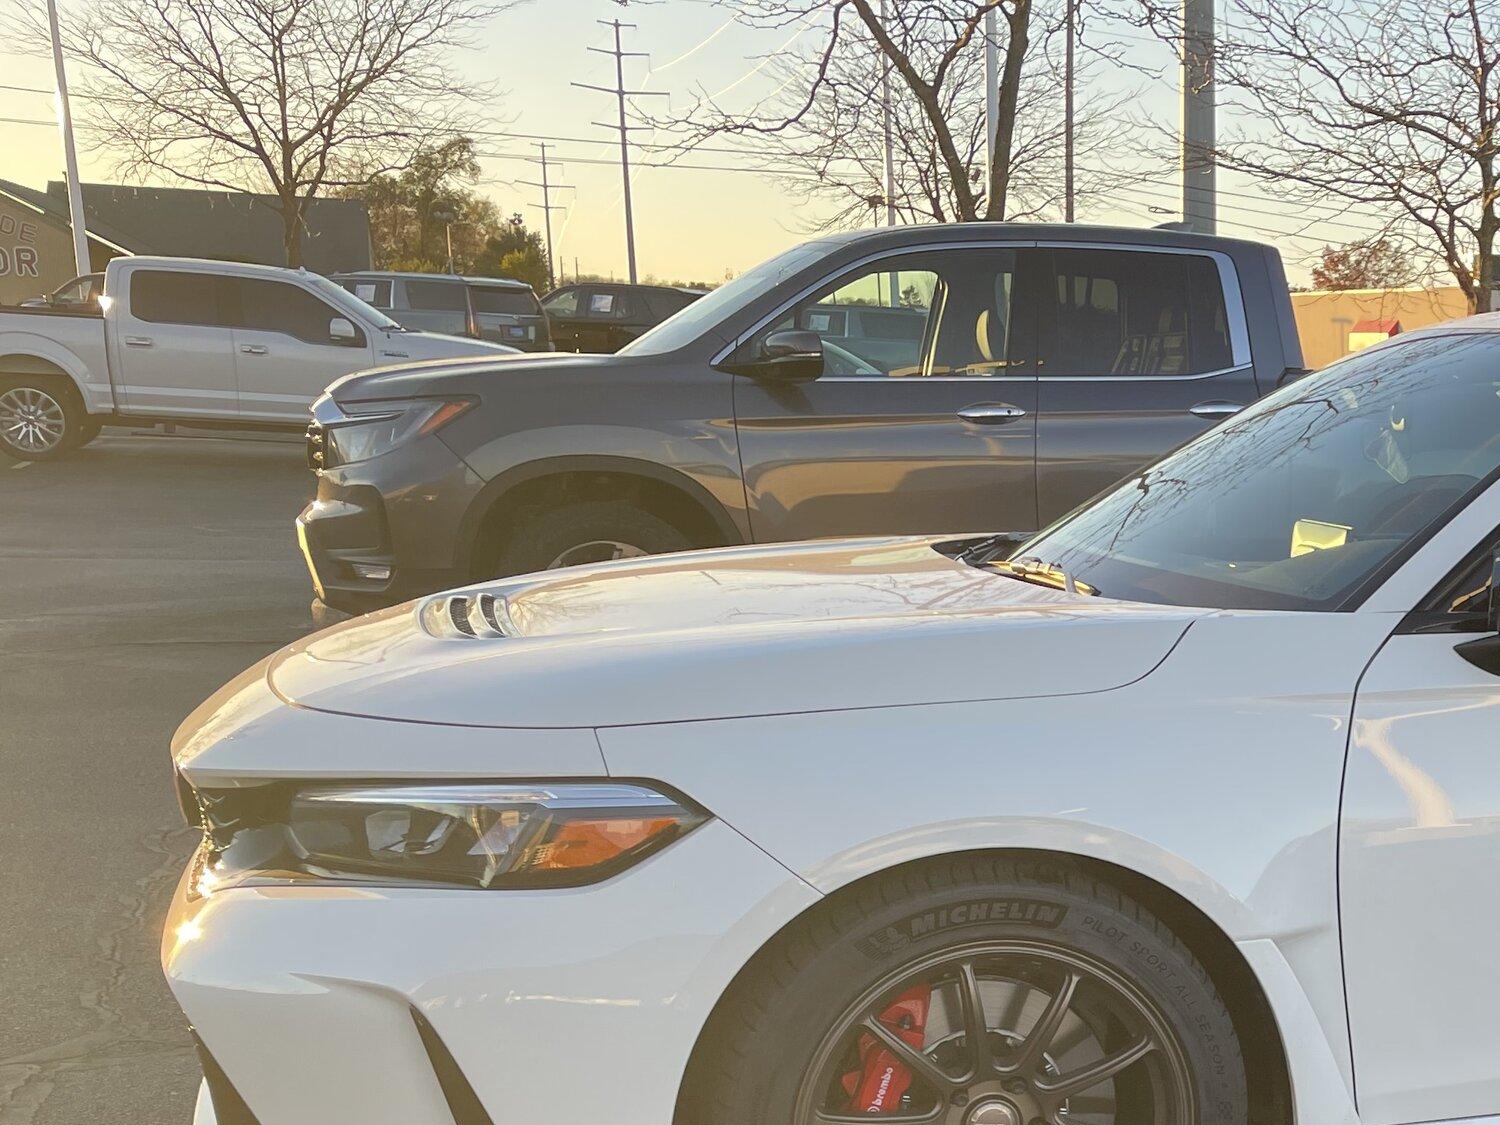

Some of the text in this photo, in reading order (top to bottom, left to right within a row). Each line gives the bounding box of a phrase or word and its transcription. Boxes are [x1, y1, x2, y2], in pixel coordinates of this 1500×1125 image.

[910, 902, 1061, 937] MICHELIN
[1082, 914, 1128, 945] PILOT
[1130, 940, 1178, 980] SPORT
[872, 1066, 894, 1107] brembo
